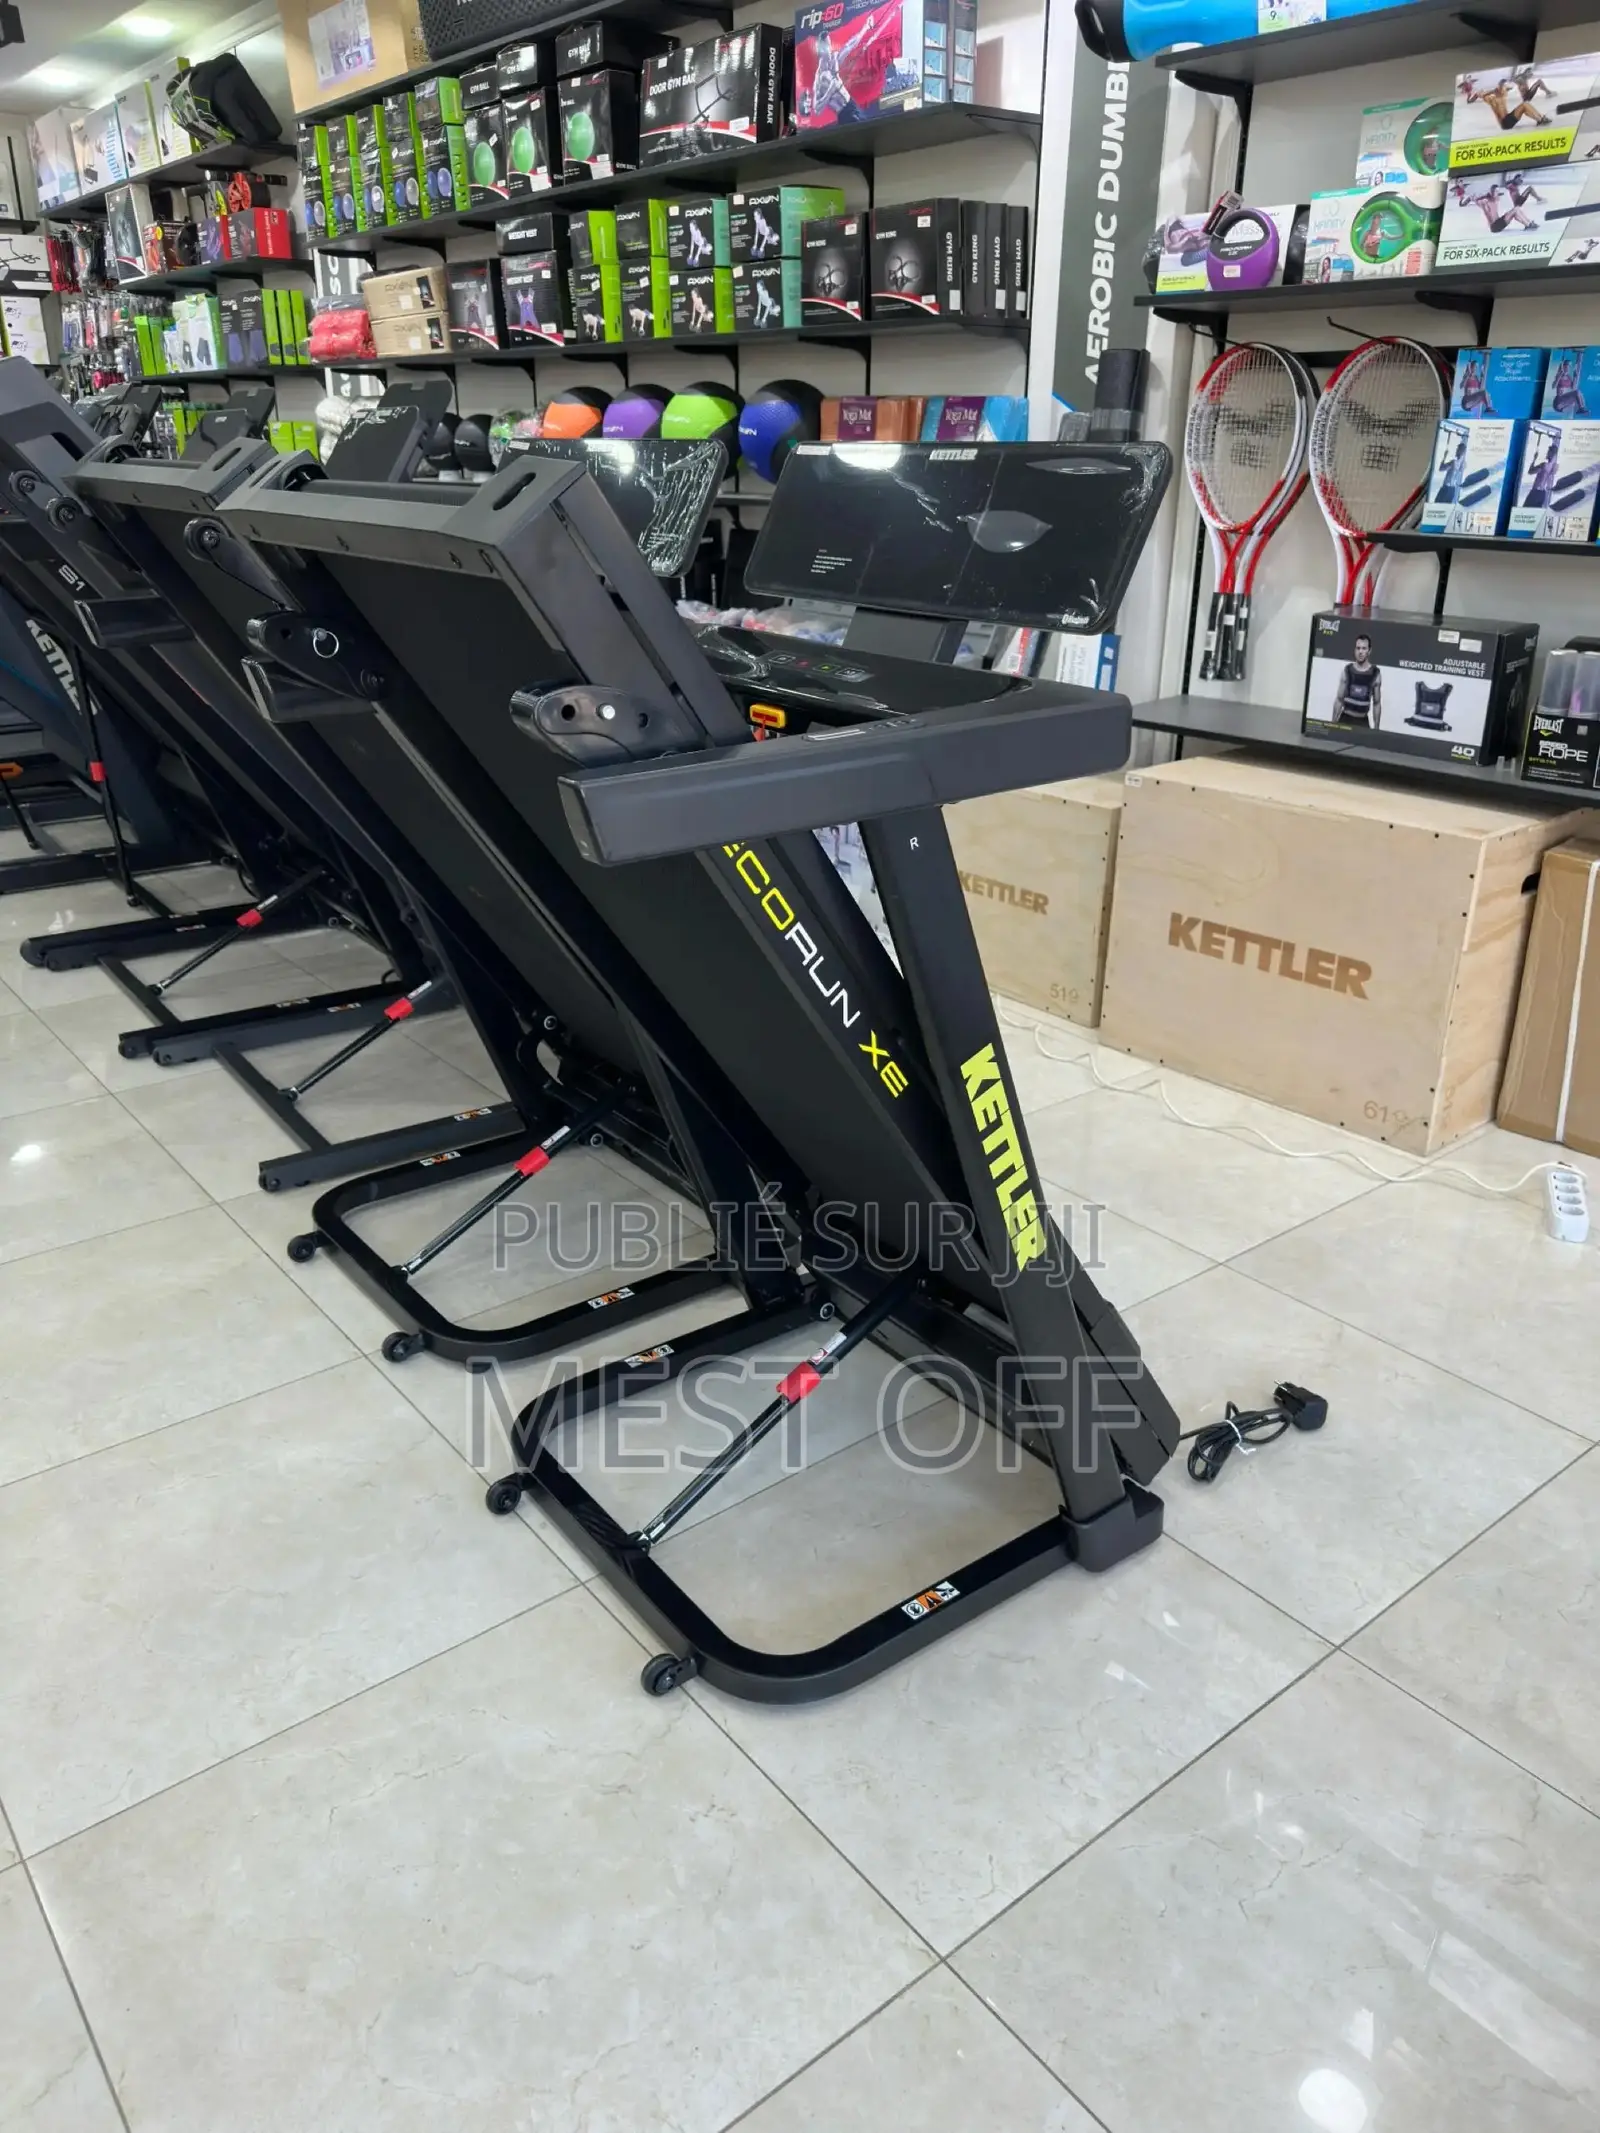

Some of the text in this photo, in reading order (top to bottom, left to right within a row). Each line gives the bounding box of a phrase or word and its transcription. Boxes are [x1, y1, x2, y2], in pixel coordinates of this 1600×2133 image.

[650, 82, 666, 96] DOOR
[667, 76, 681, 90] GYM
[766, 47, 776, 124] DOOR GYM BAR
[1455, 137, 1566, 161] FOR SIX-PACK RESULTS
[1443, 250, 1464, 260] FOR
[1464, 246, 1508, 259] SIX-PACK
[1509, 242, 1550, 255] RESULTS
[929, 448, 978, 461] KETTLER
[1399, 659, 1485, 678] WEIGHTED TRAINING VEST
[1442, 657, 1486, 670] ADJUSTABLE
[1533, 714, 1564, 734] EVERLAST
[1451, 744, 1475, 757] 40
[1538, 746, 1589, 763] ROPE
[909, 837, 919, 850] R
[958, 870, 1049, 916] KETTLER
[1168, 910, 1373, 1001] KETTLER
[960, 1042, 1047, 1273] KETTLER
